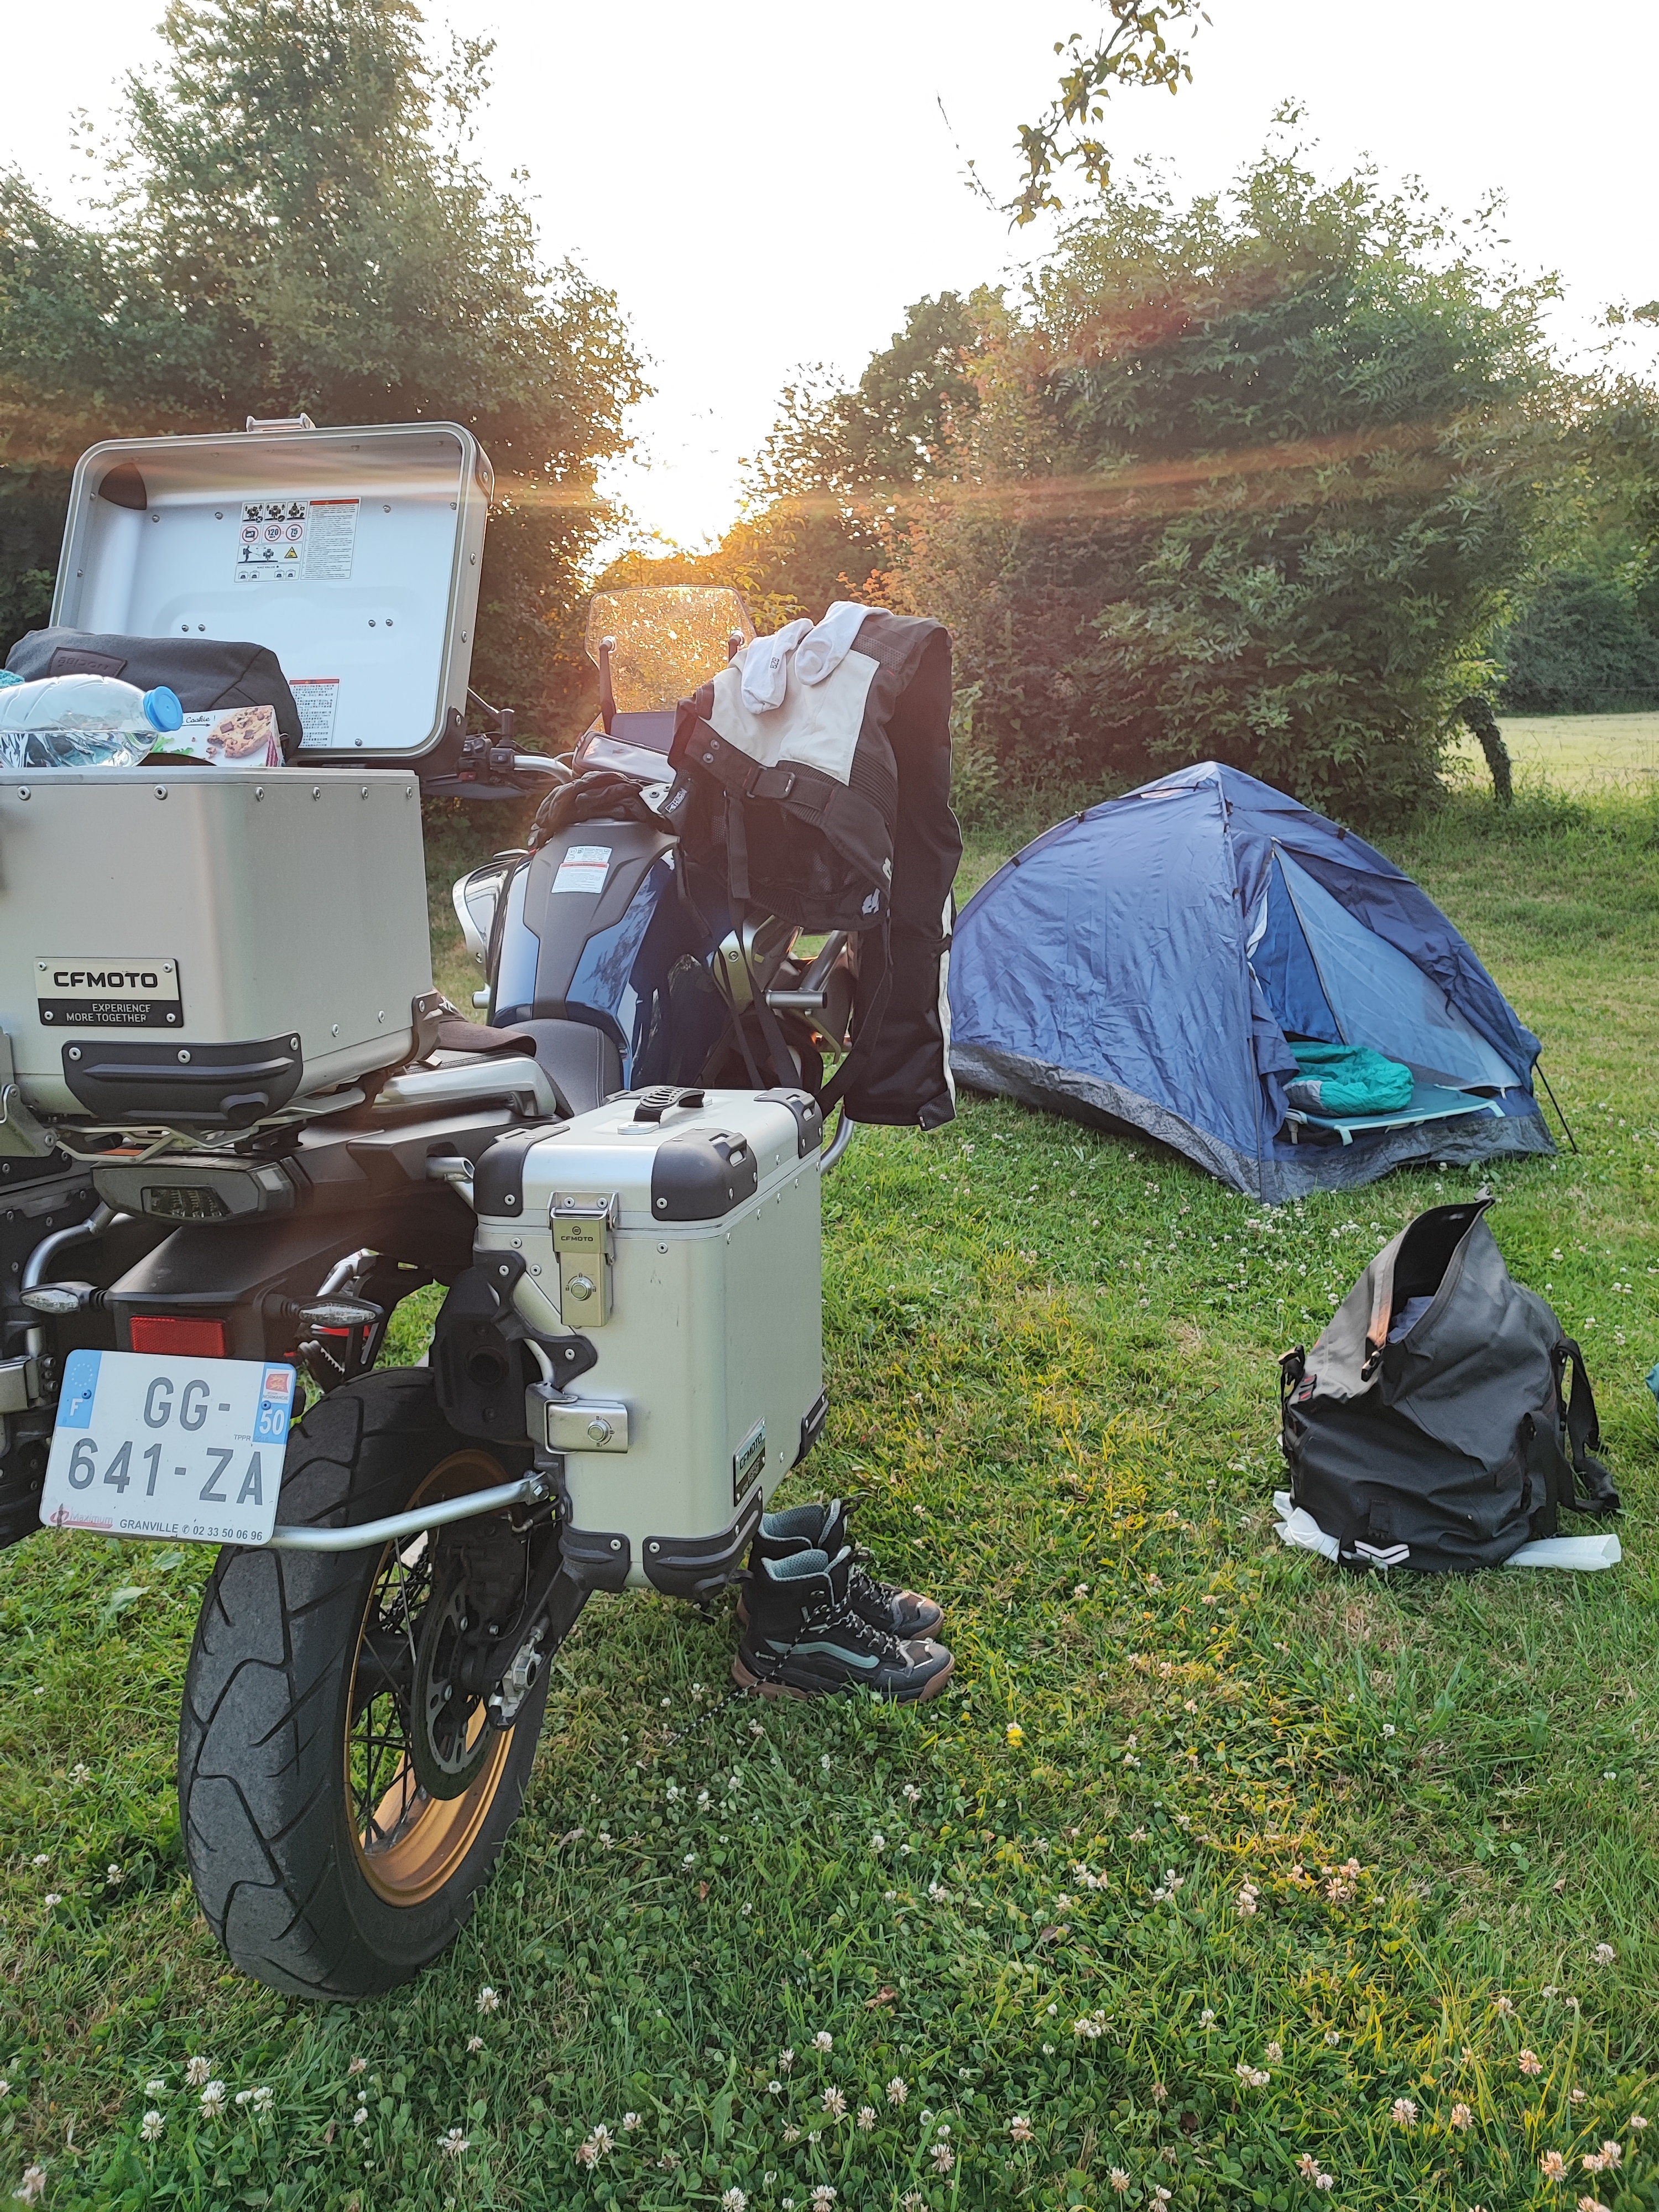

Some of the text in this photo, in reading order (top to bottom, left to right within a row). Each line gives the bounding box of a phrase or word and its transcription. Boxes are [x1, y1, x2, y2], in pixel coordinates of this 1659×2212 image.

[186, 715, 211, 723] Cookie
[54, 972, 158, 988] CFMOTO
[66, 1013, 147, 1022] MORE TOGETHER
[92, 1003, 152, 1013] EXPERIENCE
[70, 1398, 84, 1417] F
[143, 1376, 231, 1432] GG-
[259, 1408, 285, 1436] 50
[739, 1432, 762, 1470] CFMOTO
[67, 1437, 263, 1506] 641-ZA
[119, 1519, 263, 1541] GRANVILLE 02 33 50 06 96
